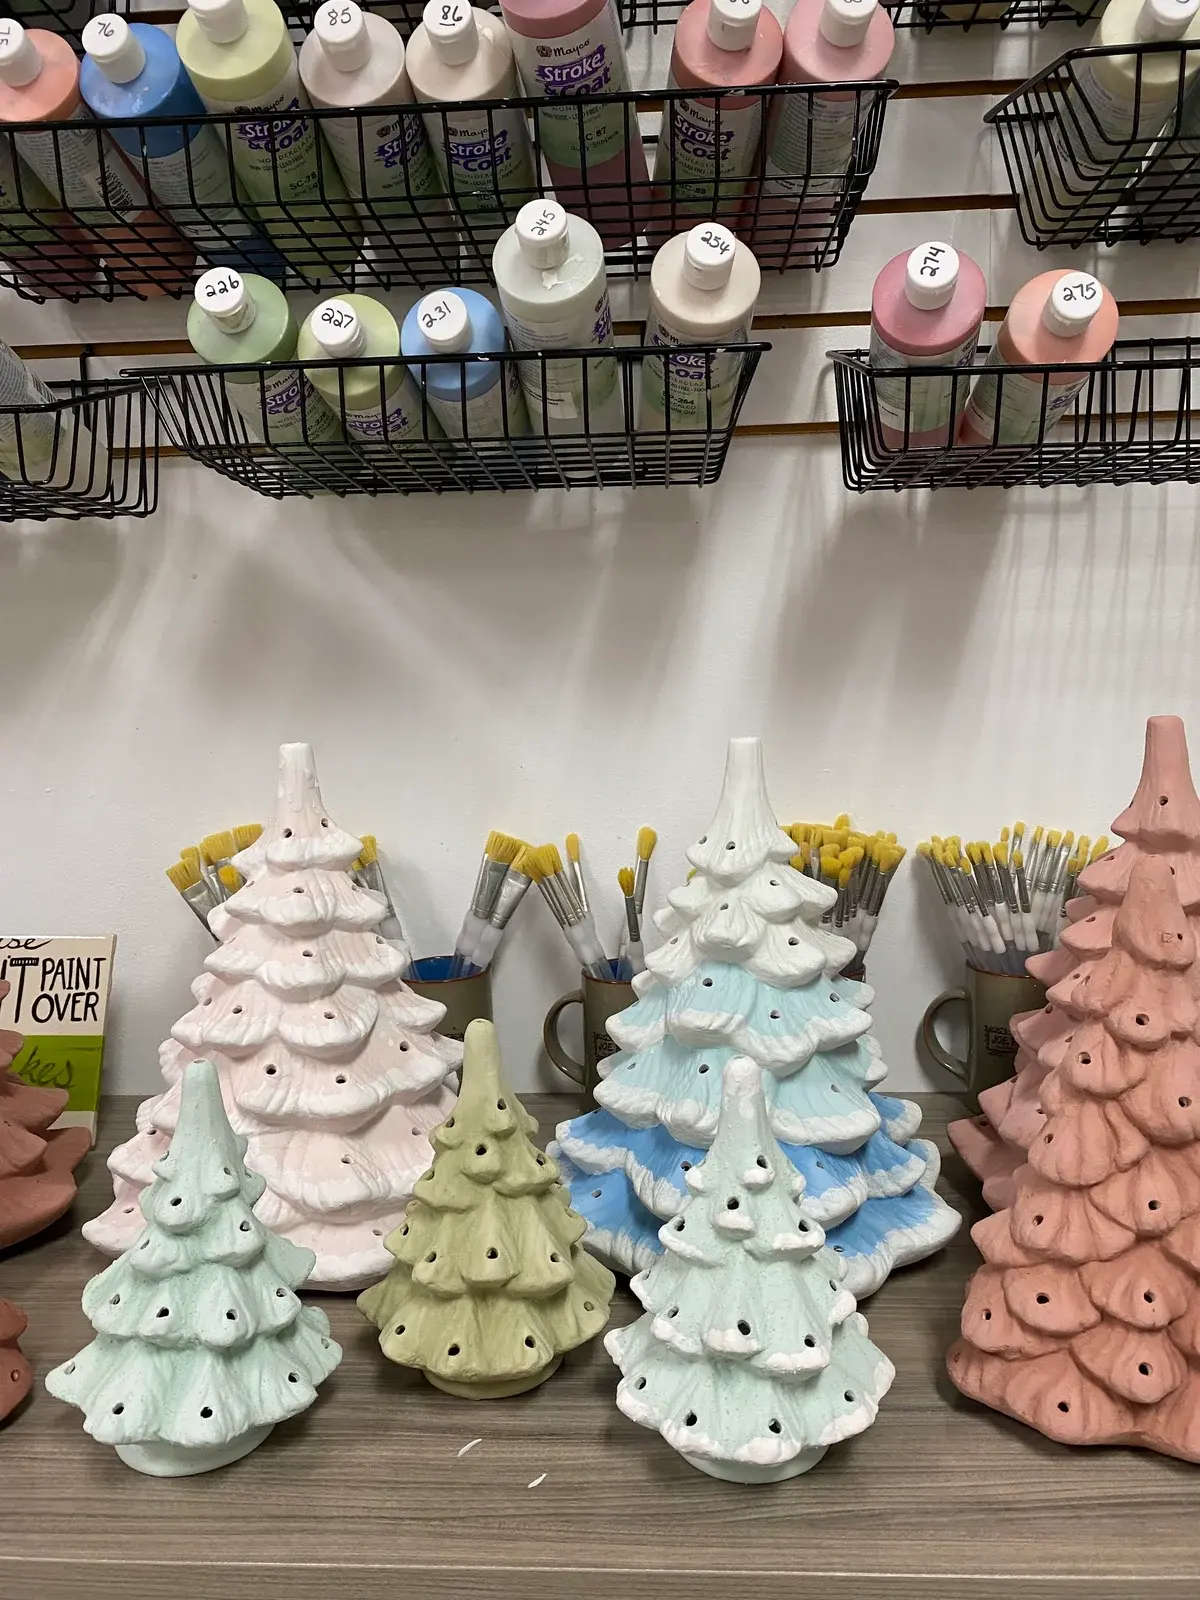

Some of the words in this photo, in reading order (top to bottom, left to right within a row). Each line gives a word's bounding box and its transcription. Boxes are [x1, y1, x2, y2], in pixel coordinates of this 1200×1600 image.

[327, 8, 351, 26] 85
[441, 5, 463, 22] 86
[97, 22, 115, 37] 76
[553, 40, 590, 57] Mayco
[544, 53, 601, 82] Stroke
[560, 65, 611, 97] Coat
[264, 119, 309, 153] Coat
[460, 128, 492, 138] Mayc
[675, 114, 727, 144] Stroke
[450, 136, 503, 156] Stroke
[681, 138, 731, 160] Coat
[463, 147, 511, 171] Coat
[531, 210, 557, 236] 245
[920, 246, 945, 277] 274
[205, 275, 240, 297] 226
[1063, 282, 1096, 302] 275
[321, 308, 354, 329] 227
[422, 301, 452, 328] 231
[41, 957, 106, 992] PAINT
[31, 992, 98, 1023] OVER
[19, 1046, 75, 1088] kes
